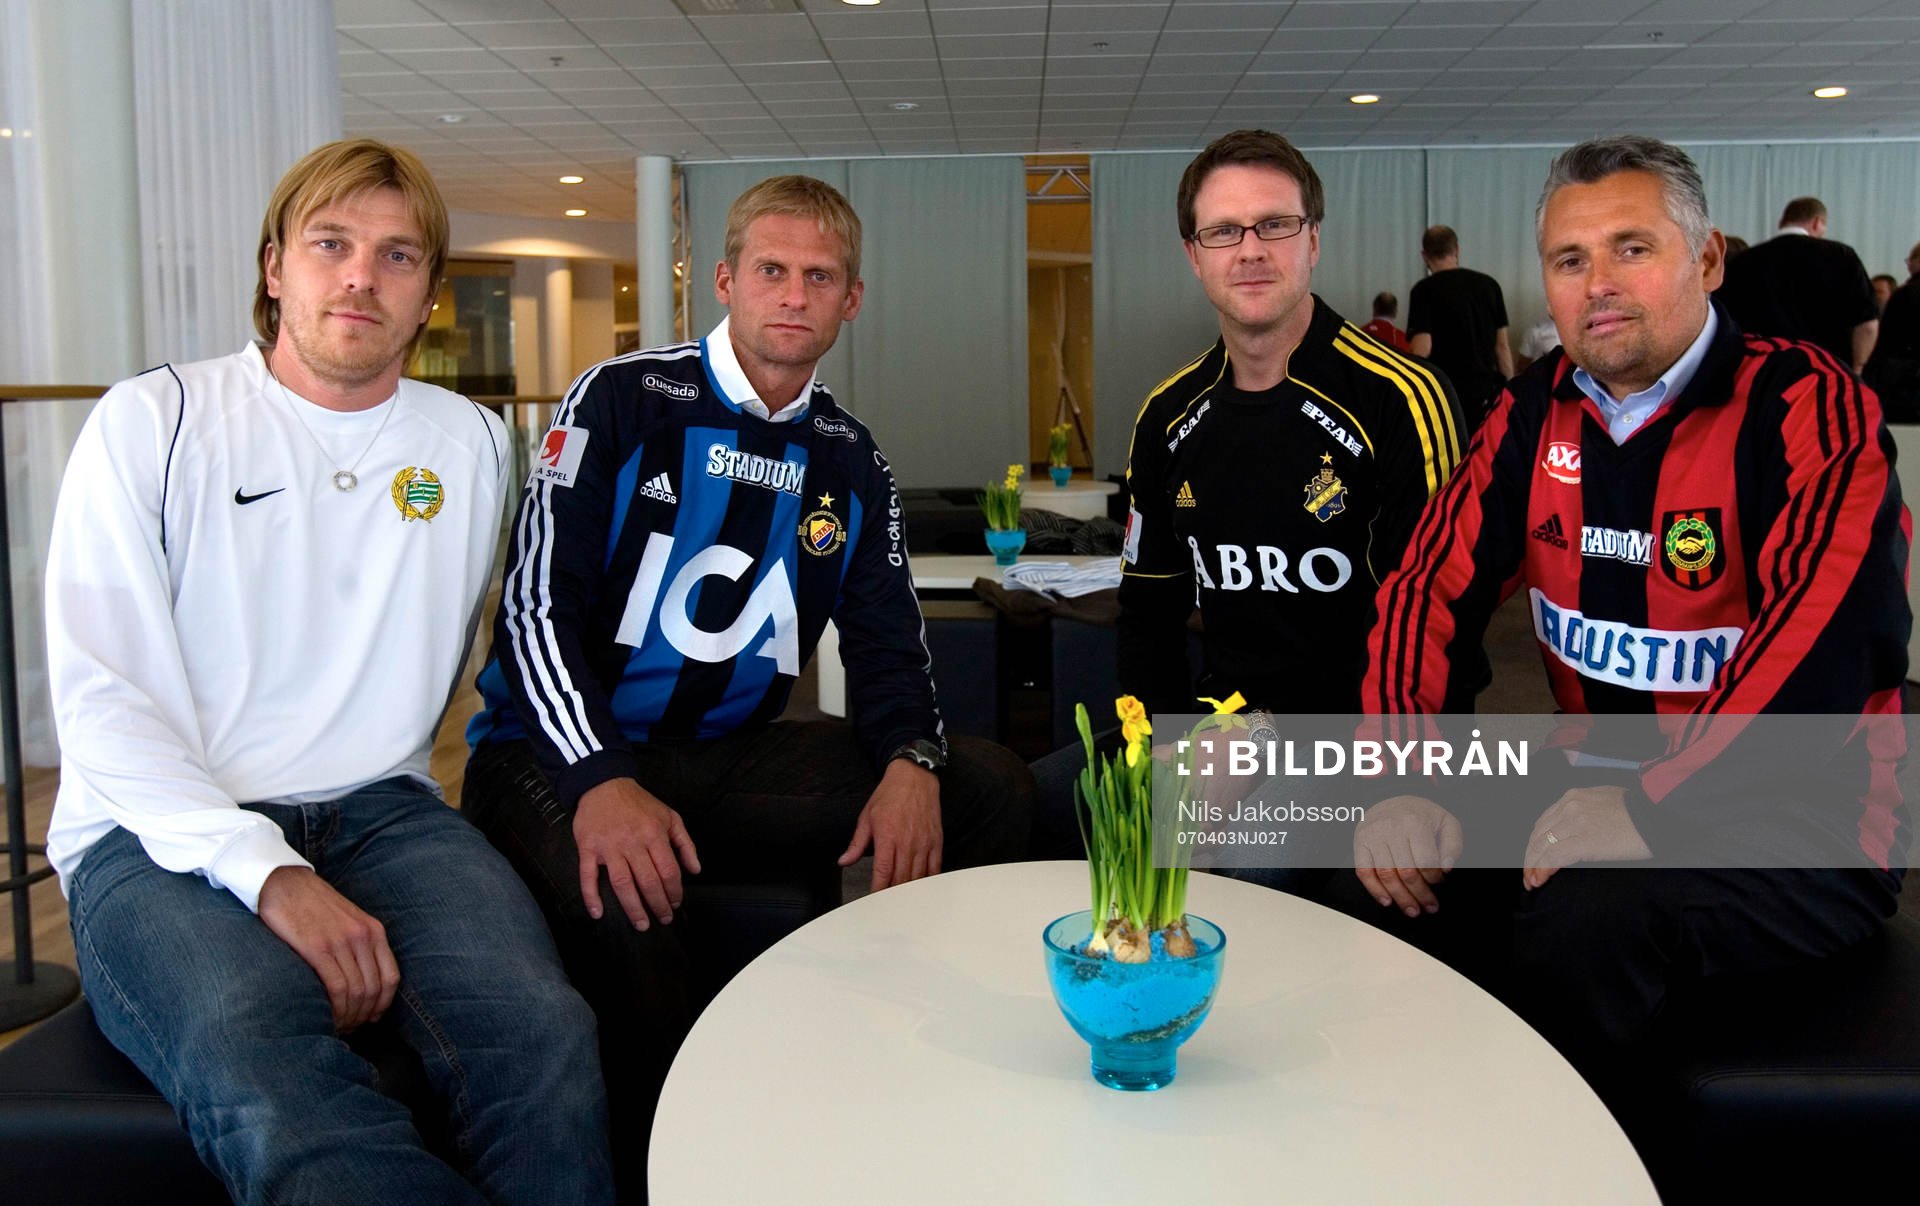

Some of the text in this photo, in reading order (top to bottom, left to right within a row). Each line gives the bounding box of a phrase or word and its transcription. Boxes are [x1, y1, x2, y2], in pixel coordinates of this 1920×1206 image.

[645, 376, 695, 397] Quesada
[814, 417, 855, 440] Quesaa
[545, 469, 568, 481] SPEL
[706, 443, 806, 498] STADIUM
[640, 486, 677, 504] adidas
[615, 532, 800, 677] ICA
